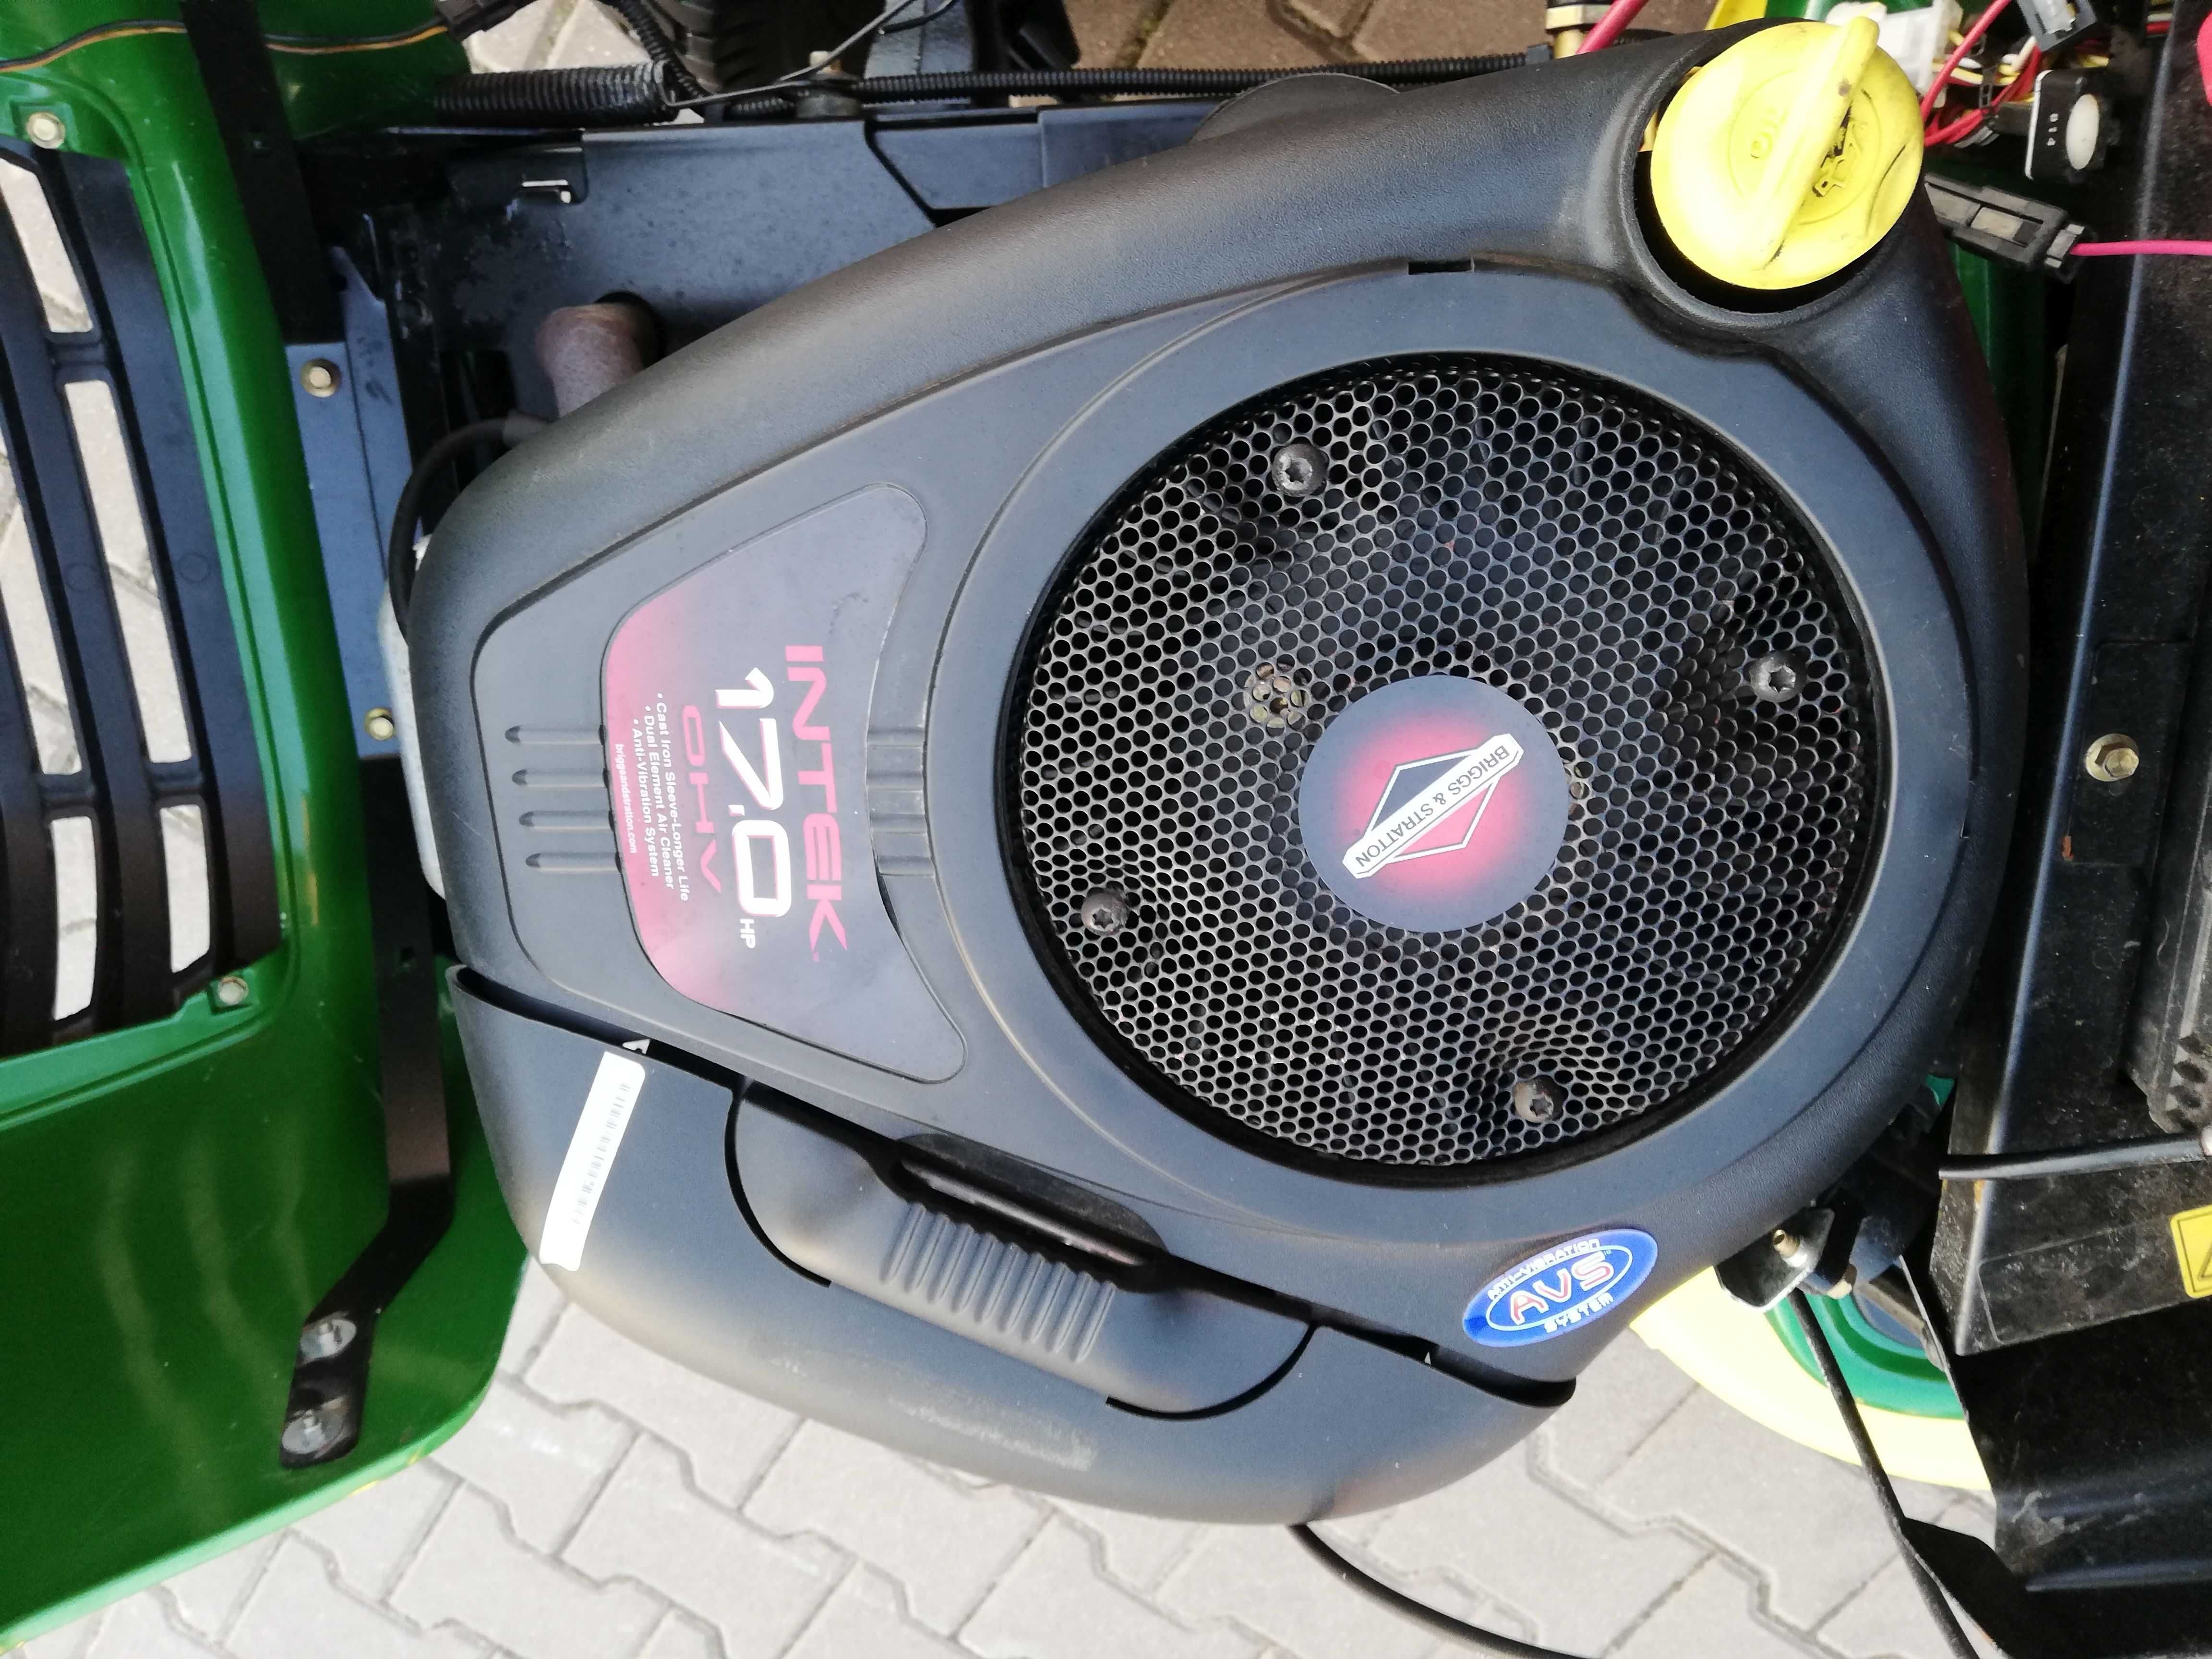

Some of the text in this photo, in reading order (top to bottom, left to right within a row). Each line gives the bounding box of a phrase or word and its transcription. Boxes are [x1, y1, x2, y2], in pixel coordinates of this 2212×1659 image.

[615, 744, 636, 853] briggsandstratton.com
[632, 728, 658, 876] Anti-Vibration System
[644, 715, 673, 889] Dual Element Air Cleaner
[656, 703, 690, 901] Cast Iron Sleeve-Longer Life
[682, 705, 721, 893] OHV
[715, 667, 792, 949] 17.0 HP
[785, 646, 847, 951] INTEK
[1355, 745, 1510, 867] BRIGGS & STRATTON
[1510, 1251, 1614, 1325] AVS
